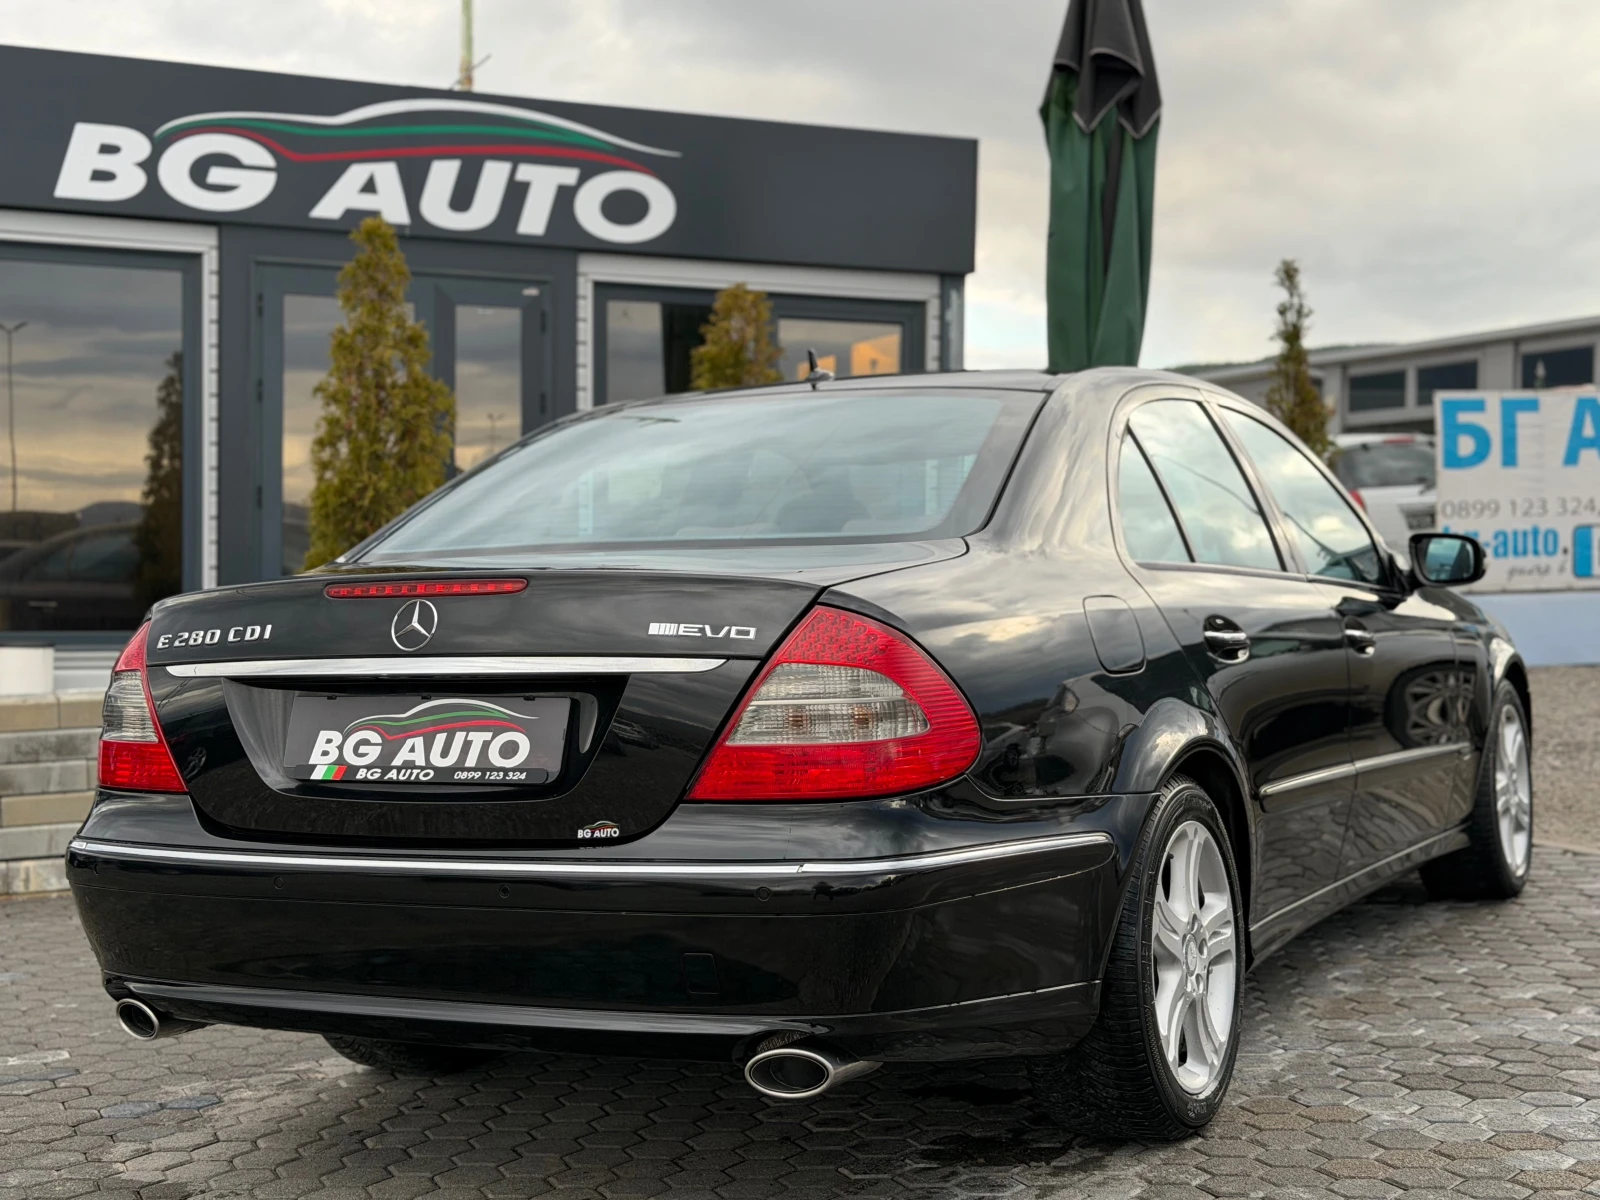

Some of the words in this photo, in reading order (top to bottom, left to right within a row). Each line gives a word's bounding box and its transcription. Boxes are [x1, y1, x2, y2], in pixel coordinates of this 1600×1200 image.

[53, 122, 277, 212] BG
[309, 159, 677, 244] AUTO
[1441, 397, 1540, 470] БГ
[1440, 499, 1501, 519] 0899
[1509, 497, 1549, 518] 123
[157, 634, 173, 649] E
[173, 629, 221, 647] 280
[227, 624, 272, 642] CDI
[677, 623, 757, 640] EVO
[308, 730, 383, 766] BG
[390, 731, 531, 768] AUTO
[355, 768, 381, 780] BG
[384, 768, 435, 781] AUTO
[453, 771, 482, 780] 0899
[484, 771, 504, 780] 123
[505, 771, 527, 780] 324
[577, 829, 591, 839] BG
[593, 827, 620, 838] AUTO
